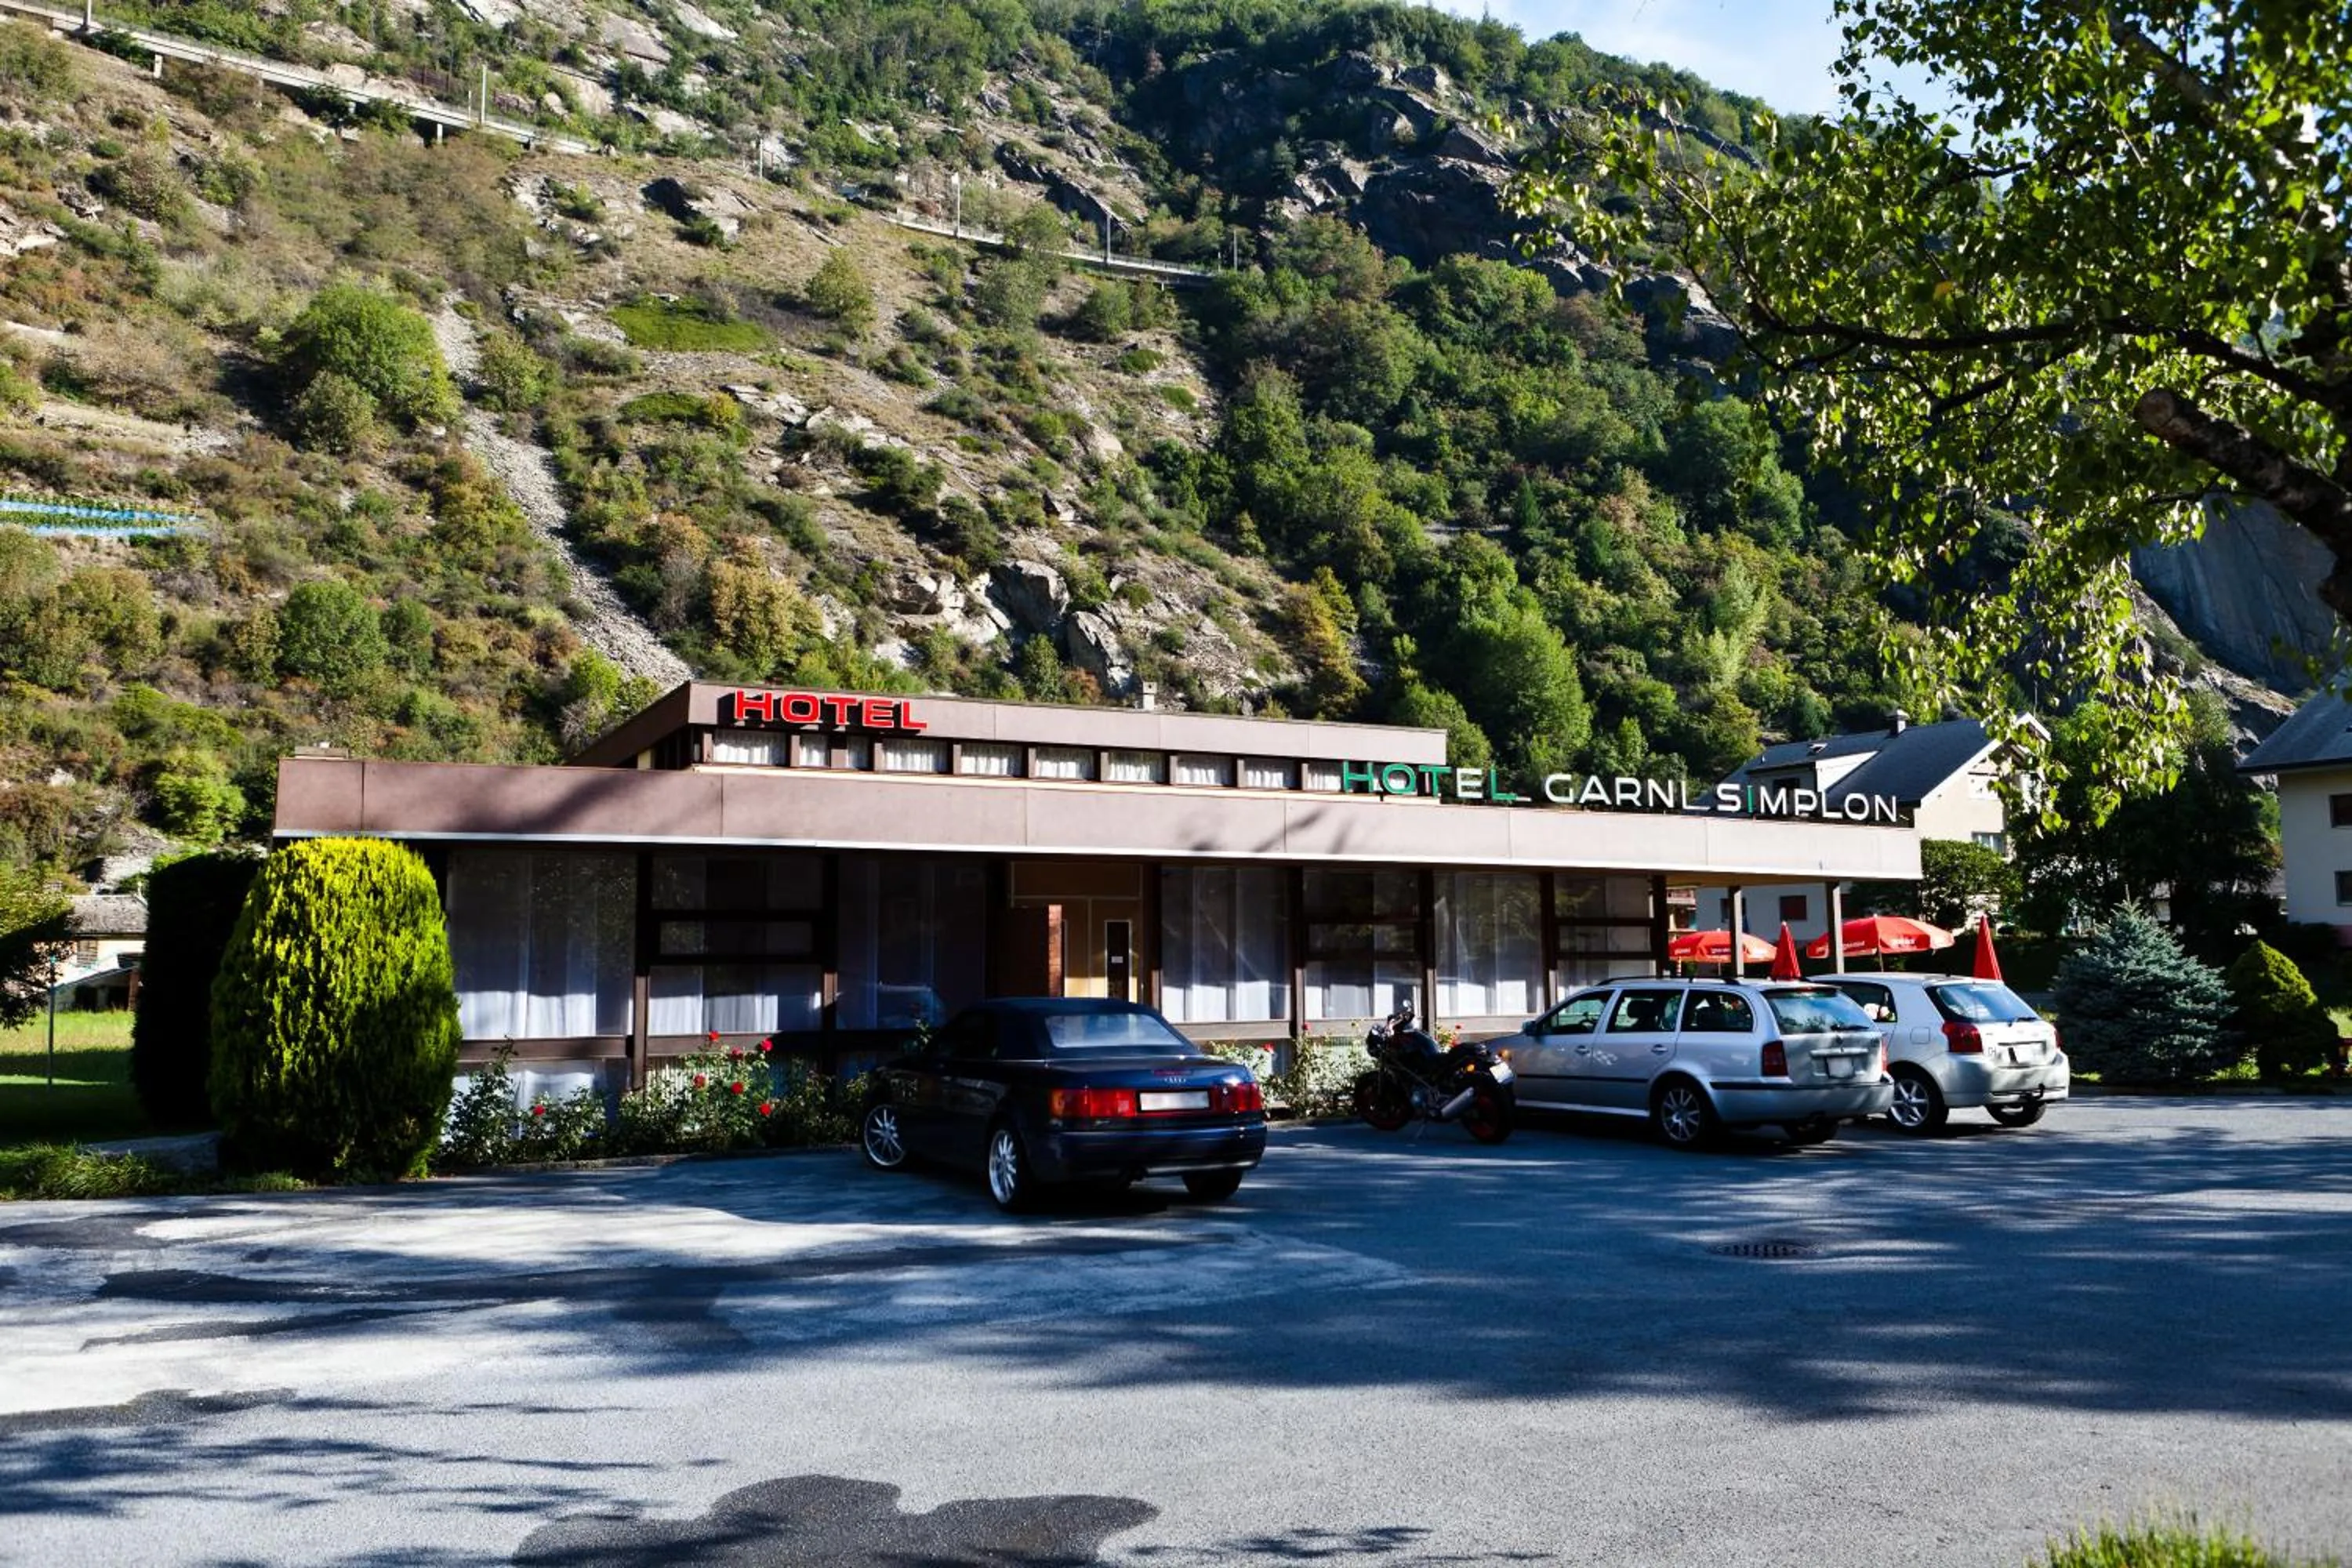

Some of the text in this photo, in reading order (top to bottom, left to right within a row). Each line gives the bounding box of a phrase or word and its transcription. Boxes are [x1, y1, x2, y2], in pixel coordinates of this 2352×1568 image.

[735, 690, 928, 729] HOTEL
[1342, 760, 1518, 801] HOTEL
[1715, 783, 1898, 823] SIMPLON
